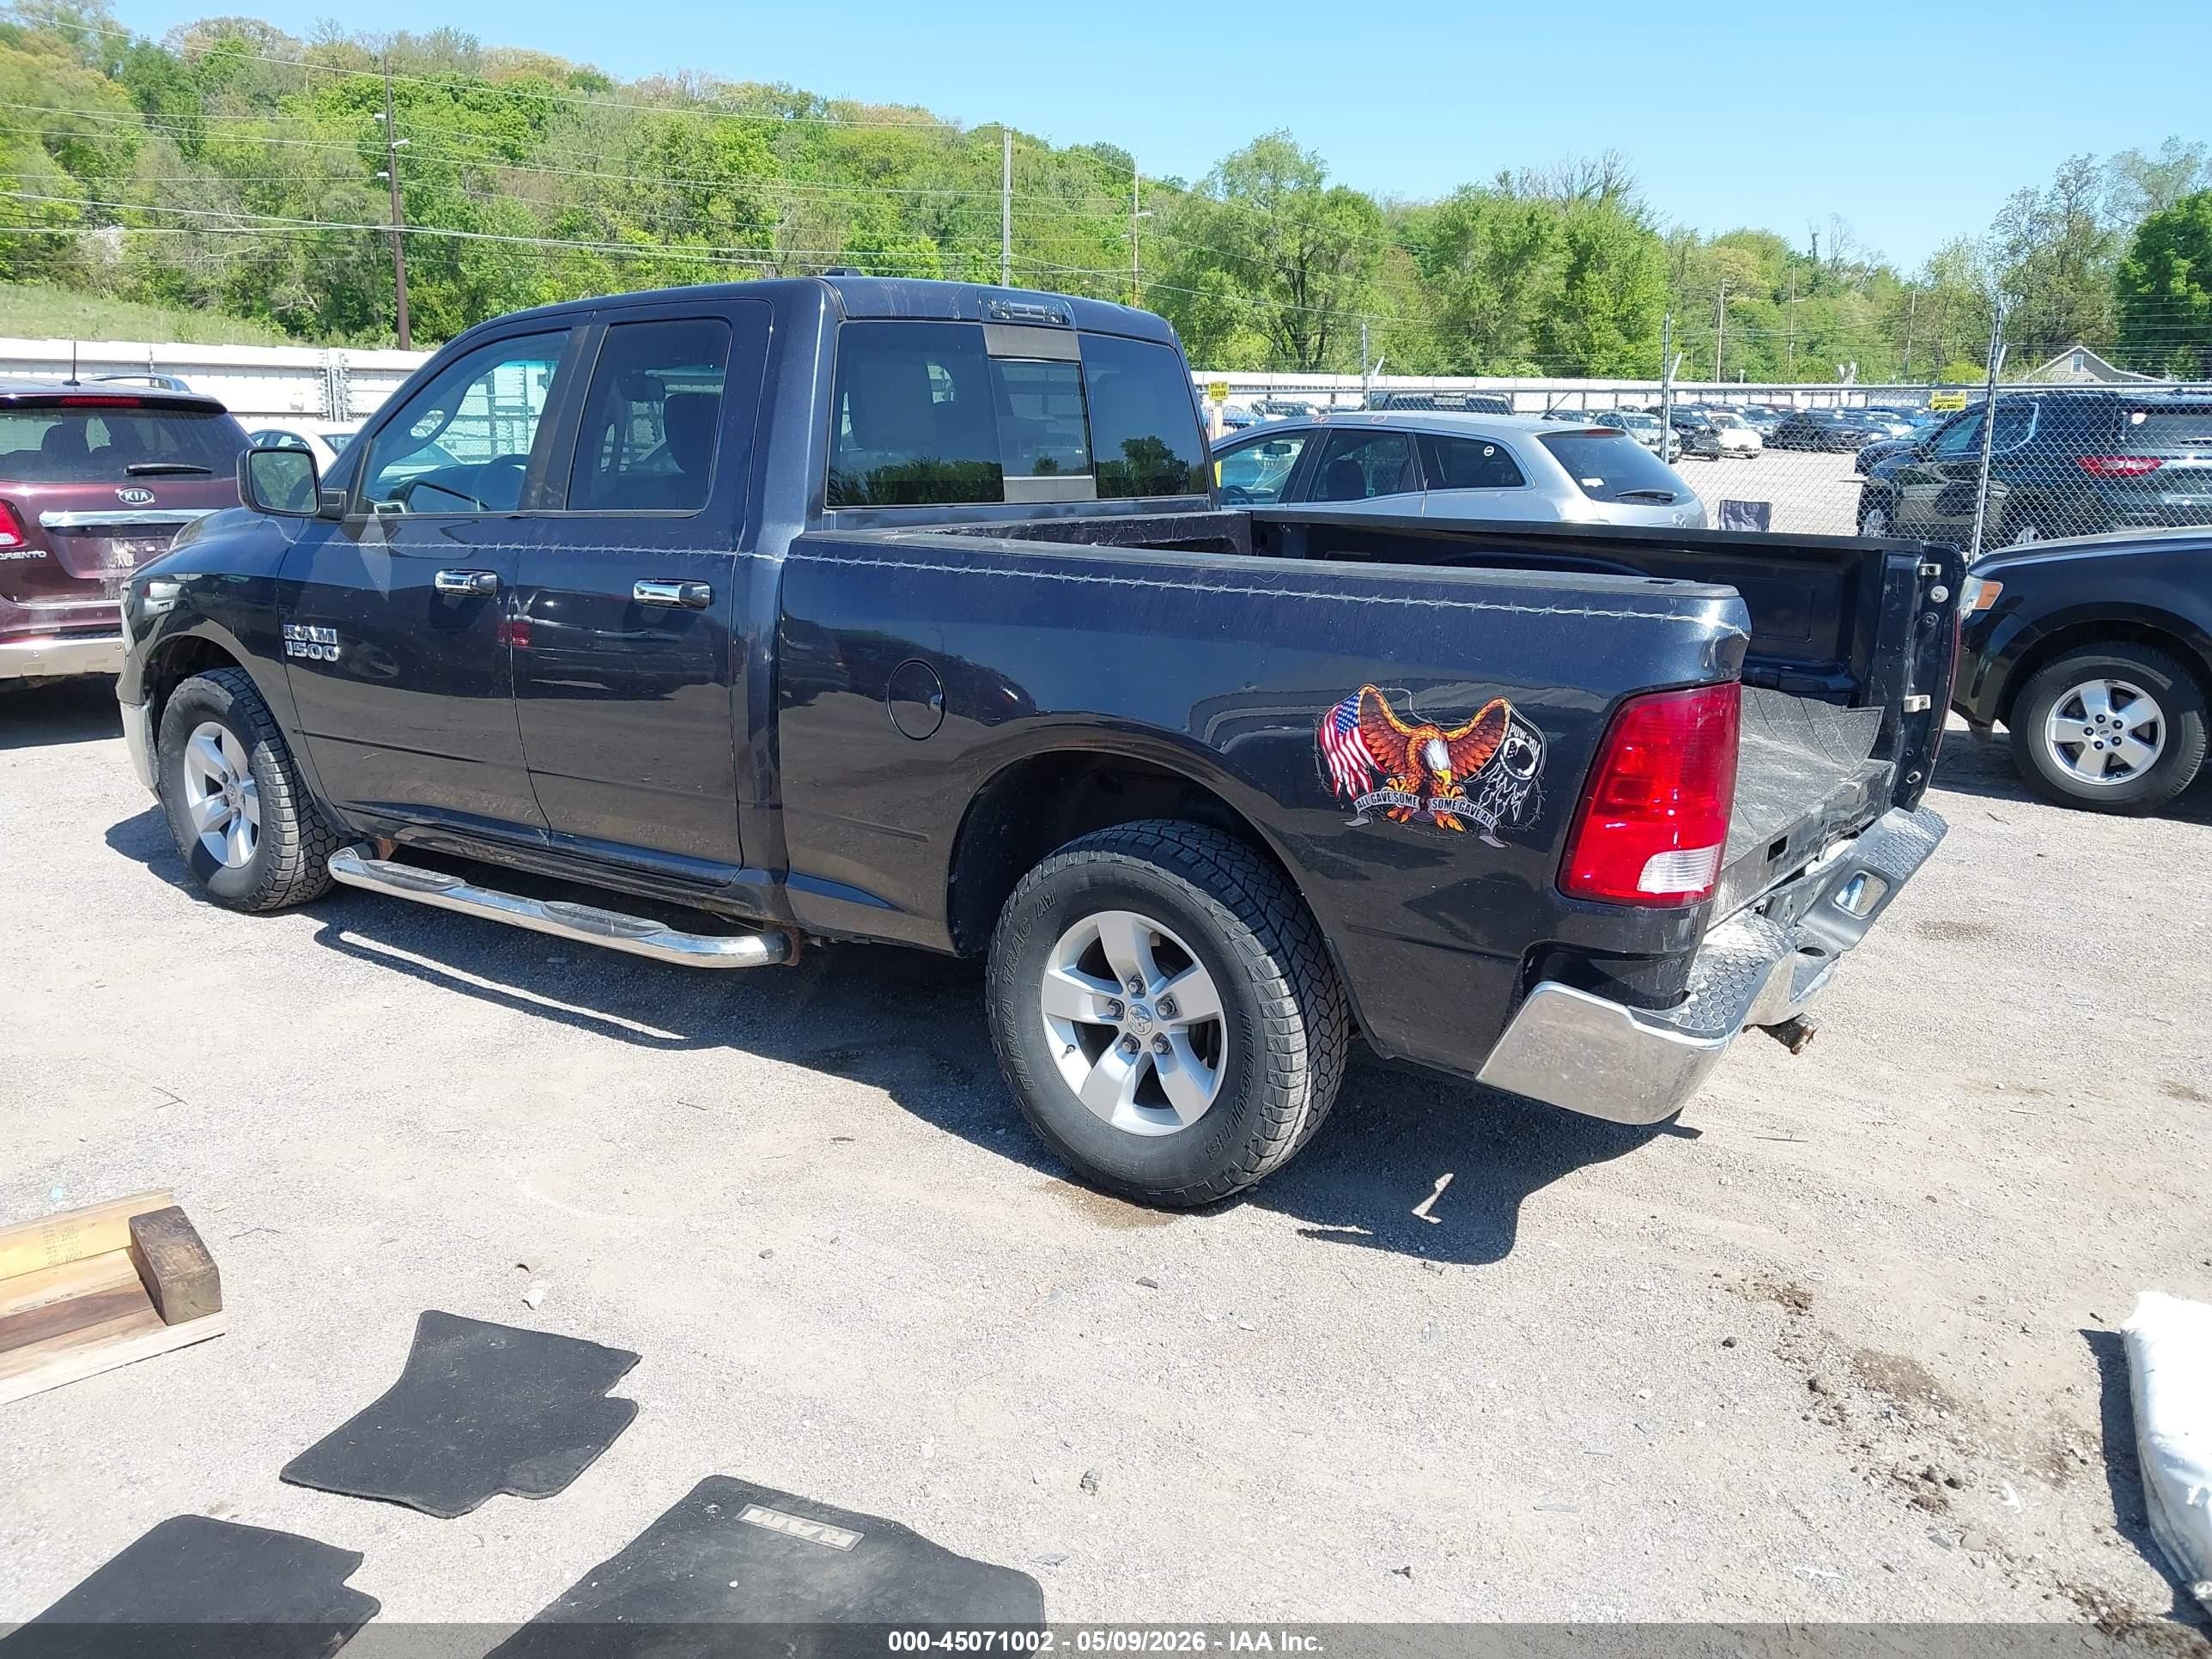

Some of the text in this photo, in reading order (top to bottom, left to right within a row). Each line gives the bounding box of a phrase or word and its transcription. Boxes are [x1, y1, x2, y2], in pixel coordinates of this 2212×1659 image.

[124, 491, 150, 501] KIA
[283, 623, 338, 645] RAM
[284, 640, 340, 662] 1500
[1357, 792, 1418, 809] ALL GAVE SOME
[1431, 798, 1496, 829] SOME GAVE ALL
[1001, 916, 1032, 987] TRAC
[1000, 998, 1036, 1091] TERRA
[1205, 1010, 1256, 1160] HERCULES
[740, 1508, 856, 1548] RAM
